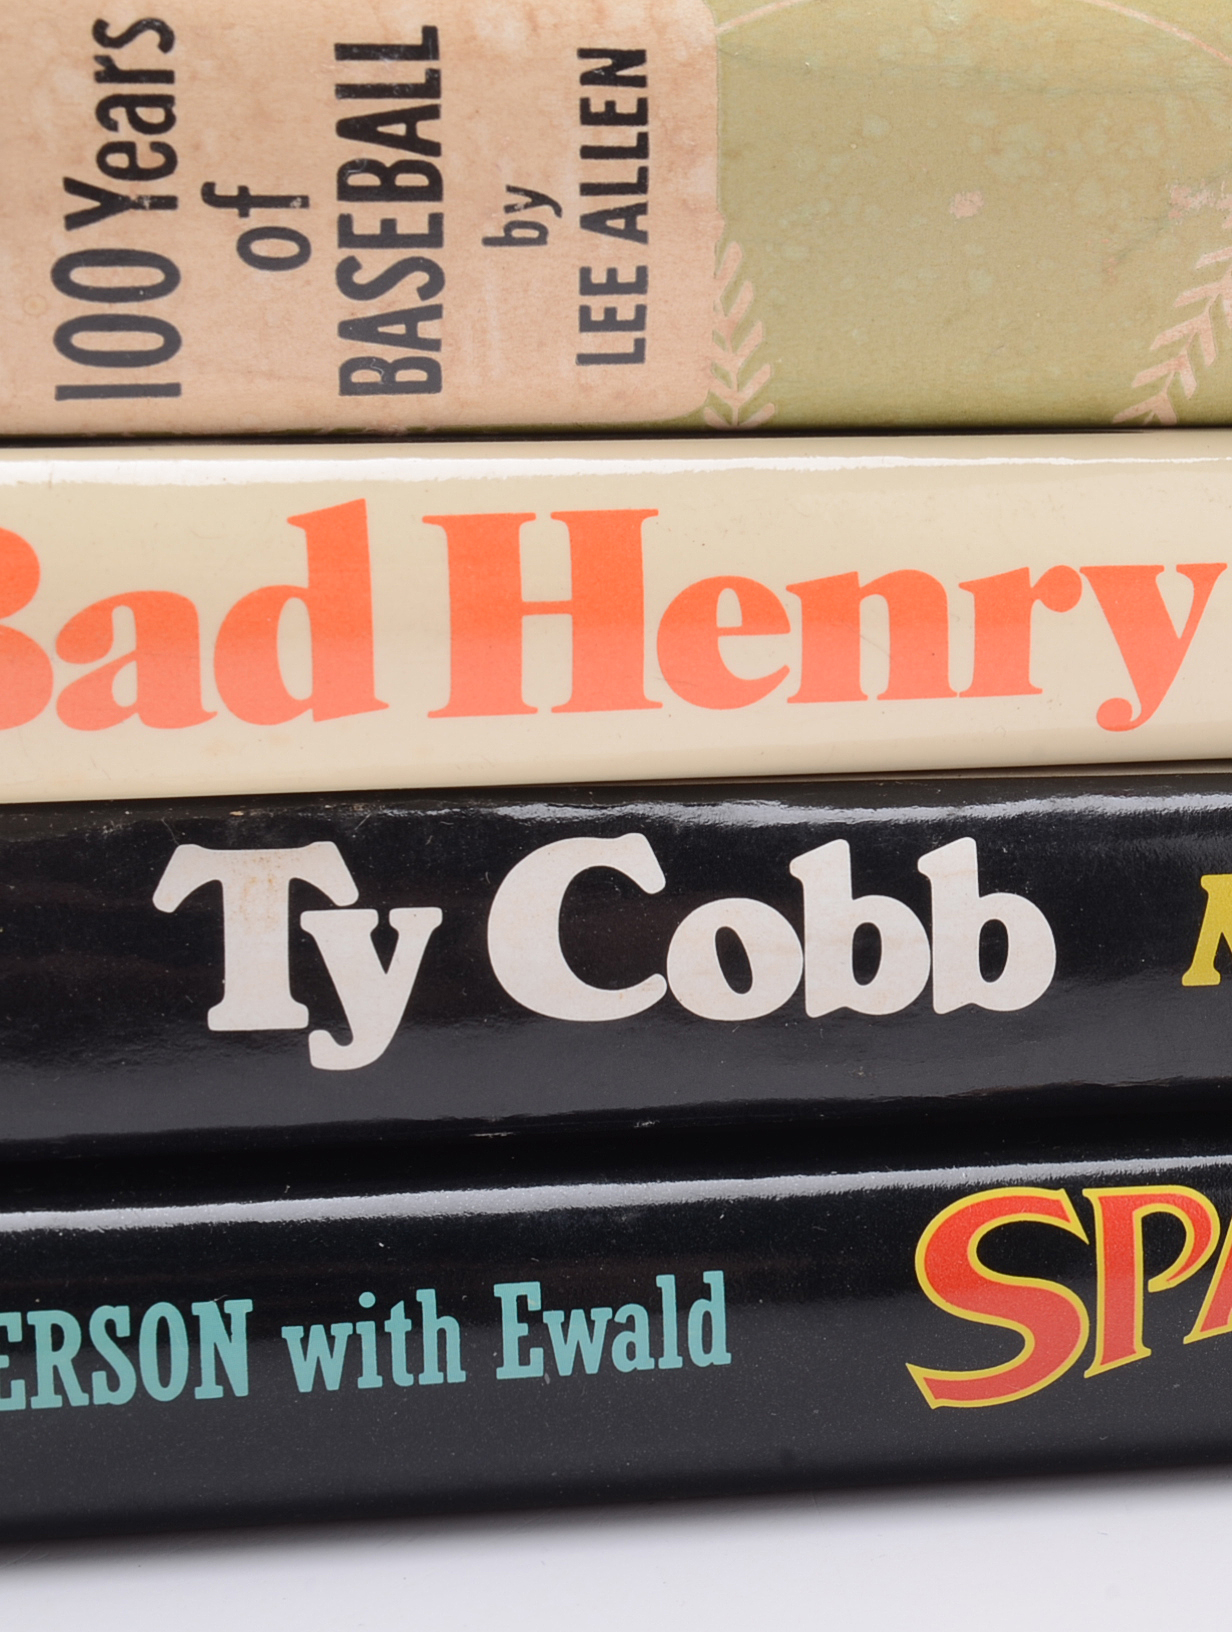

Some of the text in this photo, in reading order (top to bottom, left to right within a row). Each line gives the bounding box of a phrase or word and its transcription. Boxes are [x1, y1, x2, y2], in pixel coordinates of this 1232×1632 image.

[50, 17, 182, 401] 100 Years
[201, 181, 311, 271] of
[334, 25, 446, 397] BASEBALL
[481, 184, 562, 247] by
[576, 47, 649, 366] LEE ALLEN
[422, 508, 1227, 732] Henry
[152, 833, 1057, 1071] Ty Cobb
[281, 1289, 466, 1392] with
[494, 1270, 732, 1380] Ewald
